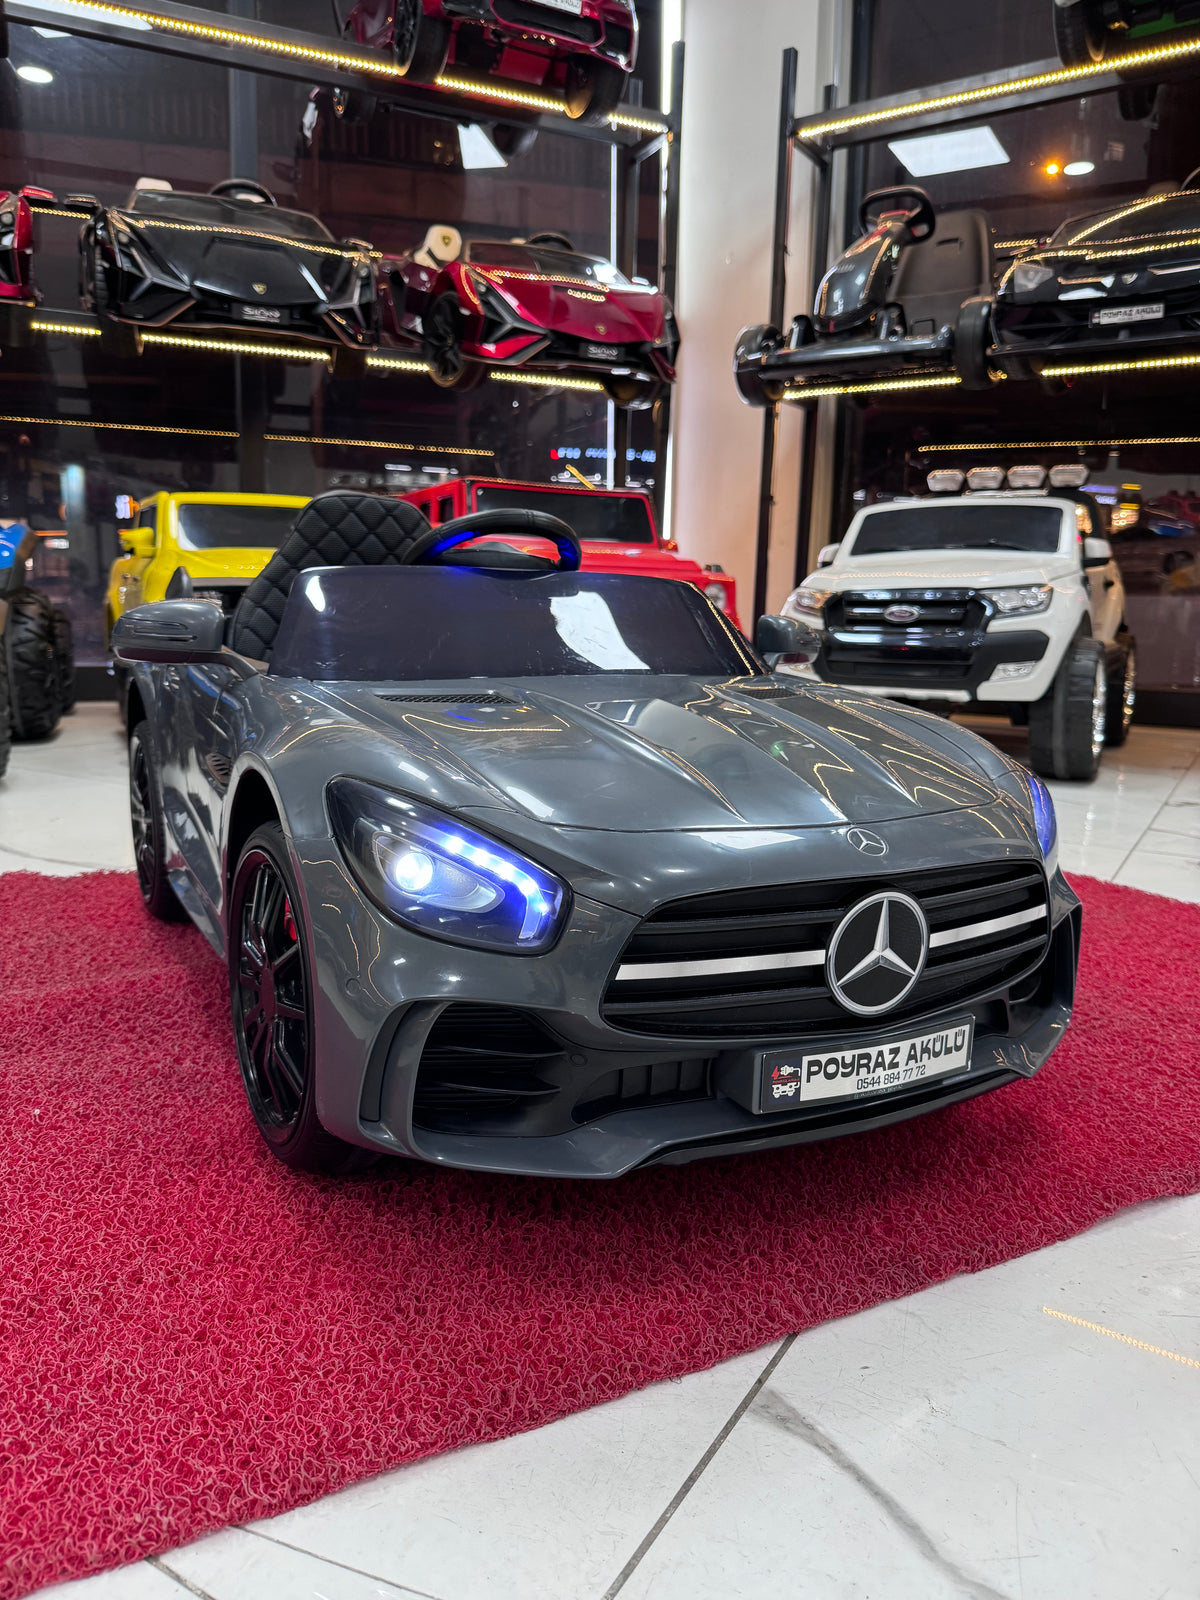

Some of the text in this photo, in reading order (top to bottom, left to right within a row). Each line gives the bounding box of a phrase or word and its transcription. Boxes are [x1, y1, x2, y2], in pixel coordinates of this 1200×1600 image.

[807, 1029, 966, 1083] POYRAZ AKÜLÜ
[857, 1073, 881, 1091] 0544
[902, 1067, 914, 1081] 77
[915, 1064, 926, 1079] 72
